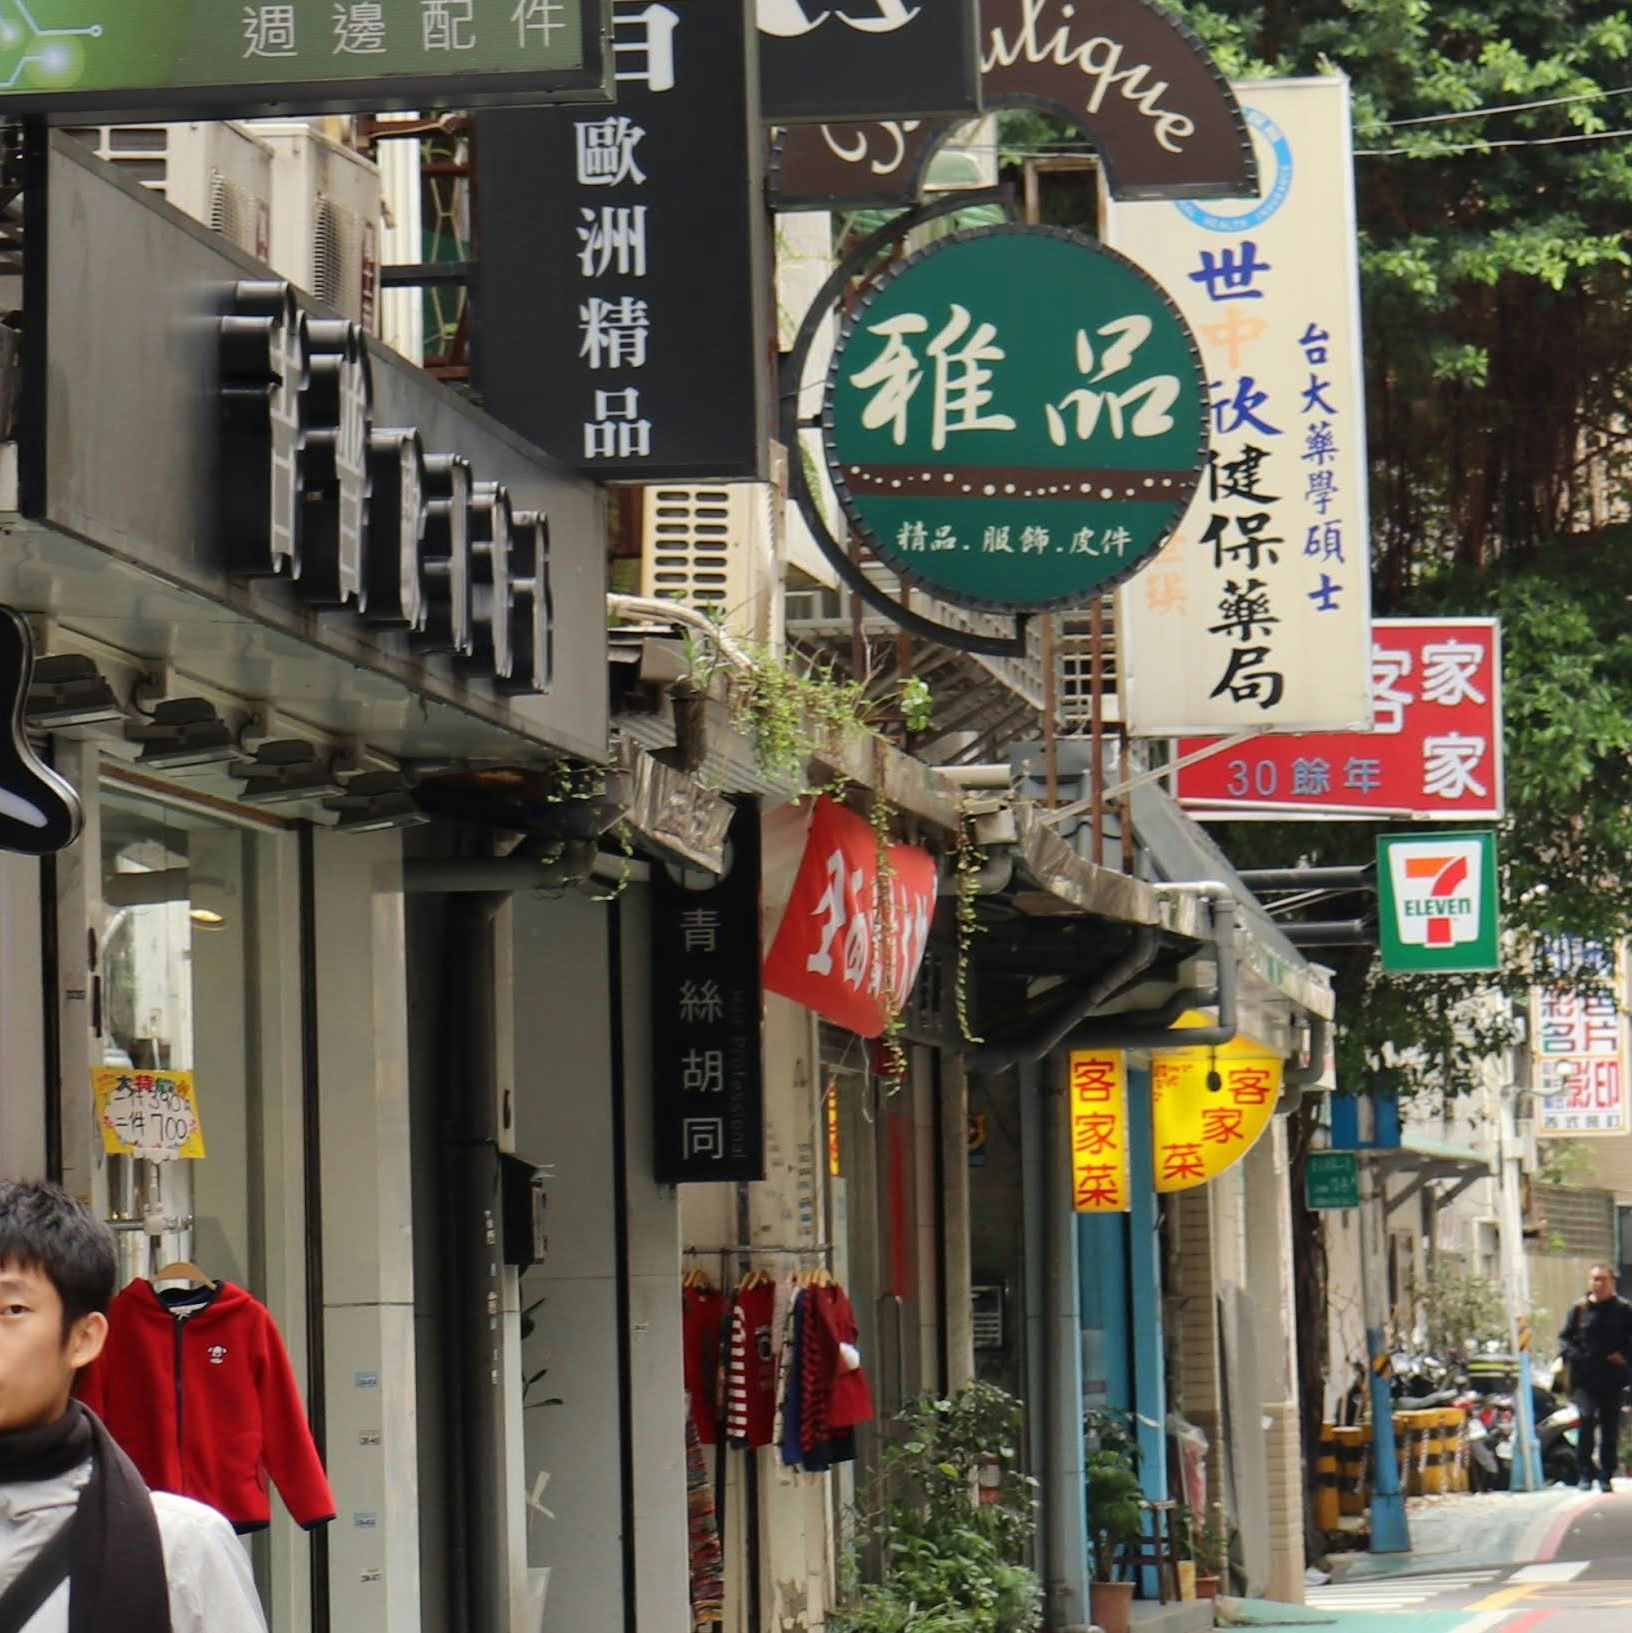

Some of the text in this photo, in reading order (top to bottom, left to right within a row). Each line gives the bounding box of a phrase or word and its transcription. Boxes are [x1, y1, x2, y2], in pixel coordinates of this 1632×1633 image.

[573, 116, 652, 459] 歐洲精品
[849, 303, 1182, 451] 雅品
[1297, 323, 1345, 612] 台大藥學碩士
[679, 908, 723, 1160] 青絲胡同
[1543, 1021, 1617, 1053] 名片
[1073, 1058, 1118, 1206] 客家菜
[1162, 1067, 1271, 1181] 客家菜
